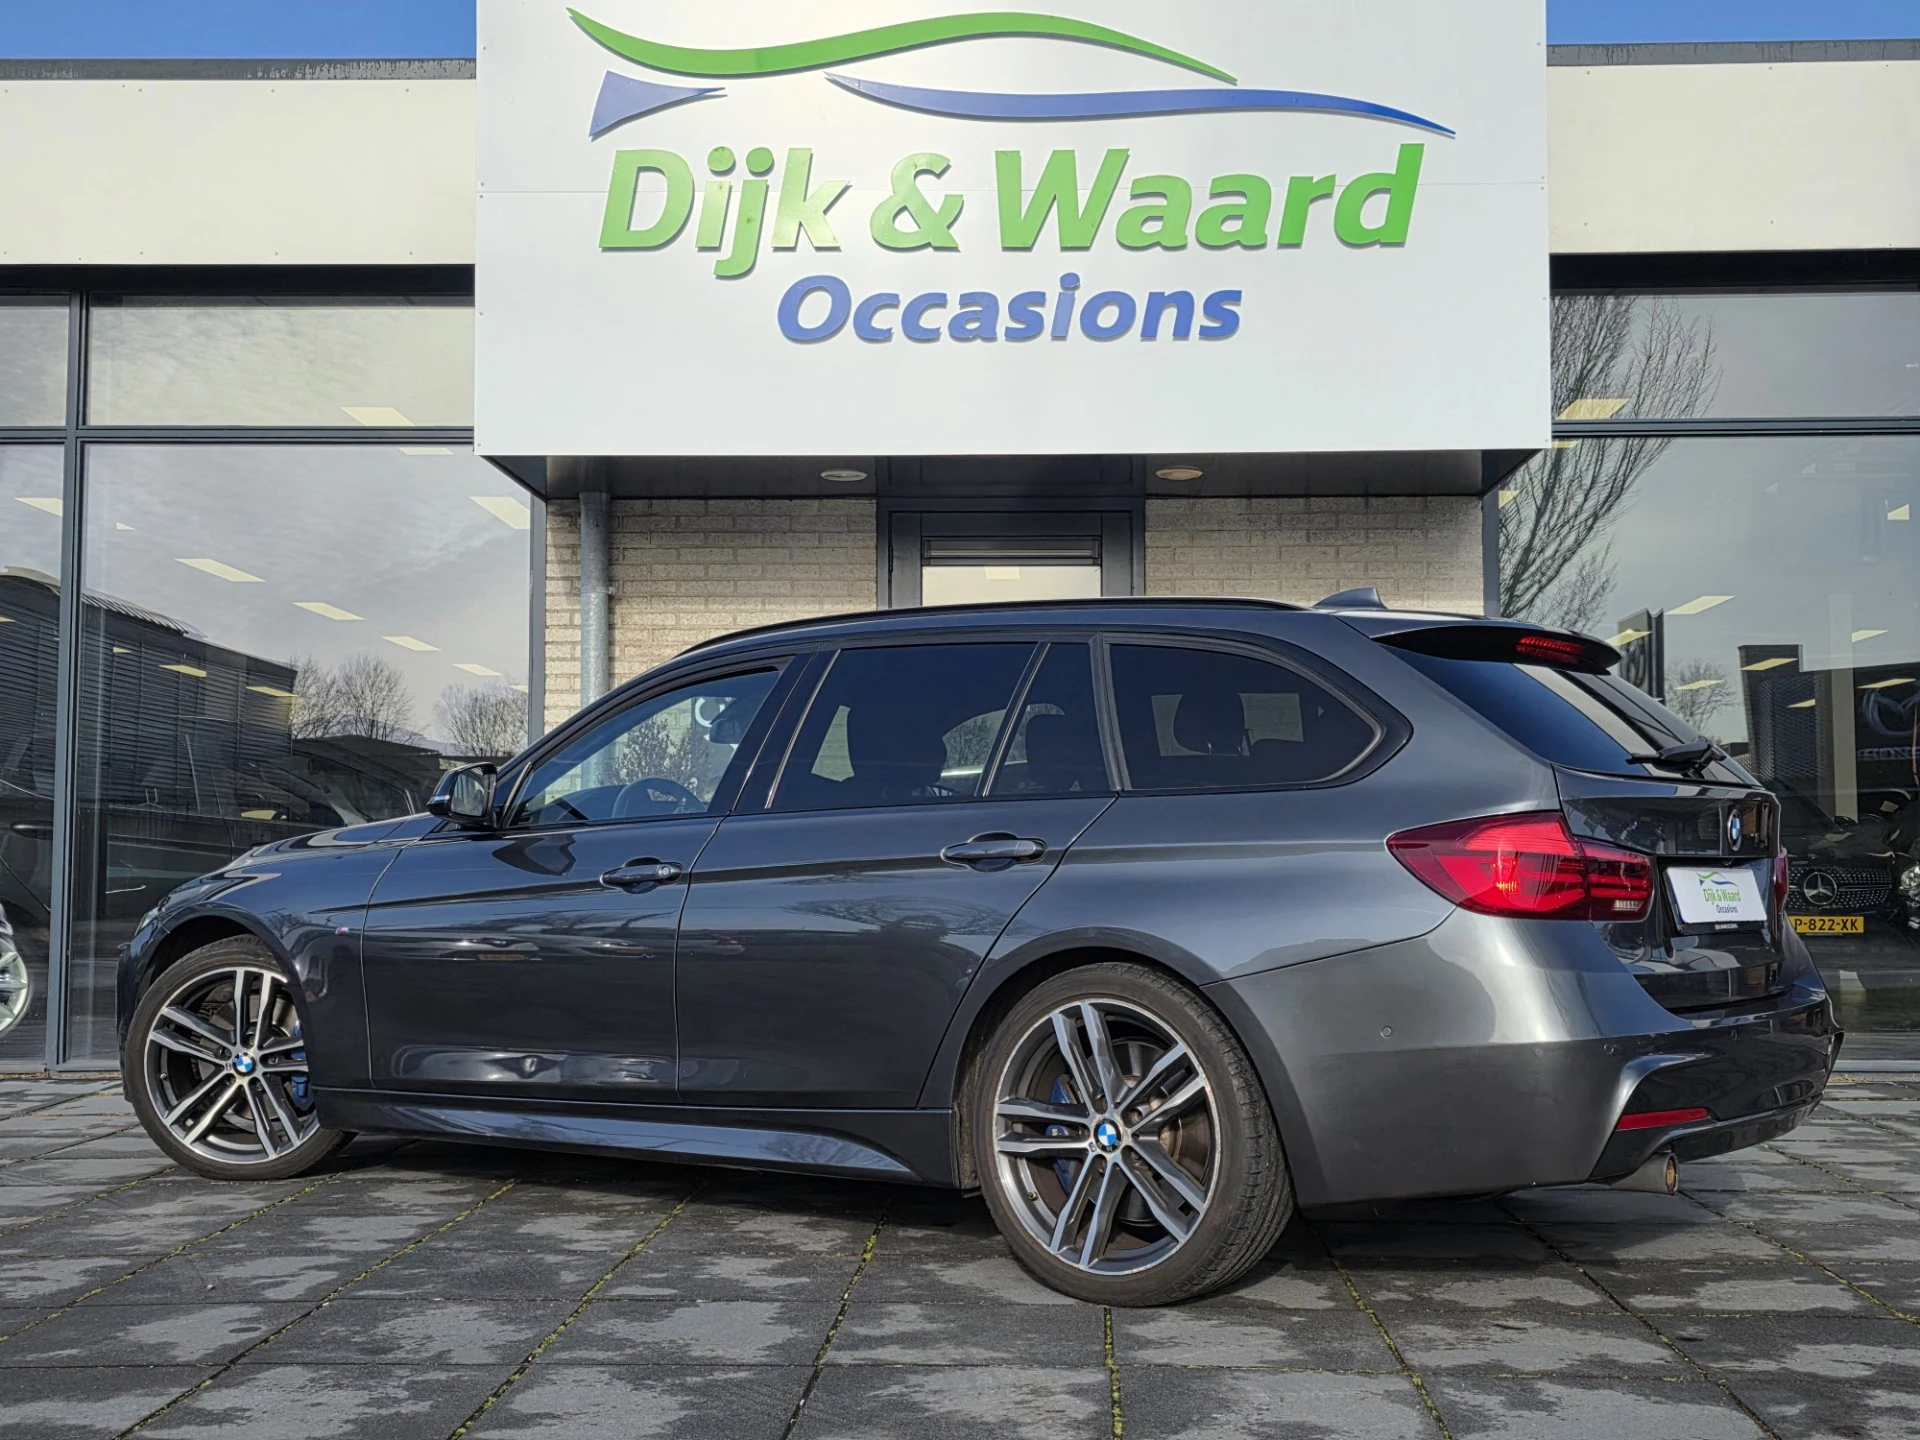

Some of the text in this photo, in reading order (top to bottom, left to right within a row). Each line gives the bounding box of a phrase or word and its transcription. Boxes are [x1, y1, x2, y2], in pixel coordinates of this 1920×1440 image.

[598, 142, 1426, 278] Dijk & Waard
[777, 272, 1243, 343] Occasions
[1702, 888, 1716, 905] Dijk
[1720, 889, 1741, 902] Waard
[1716, 904, 1738, 914] Occasions
[1794, 918, 1859, 931] P-822-XK
